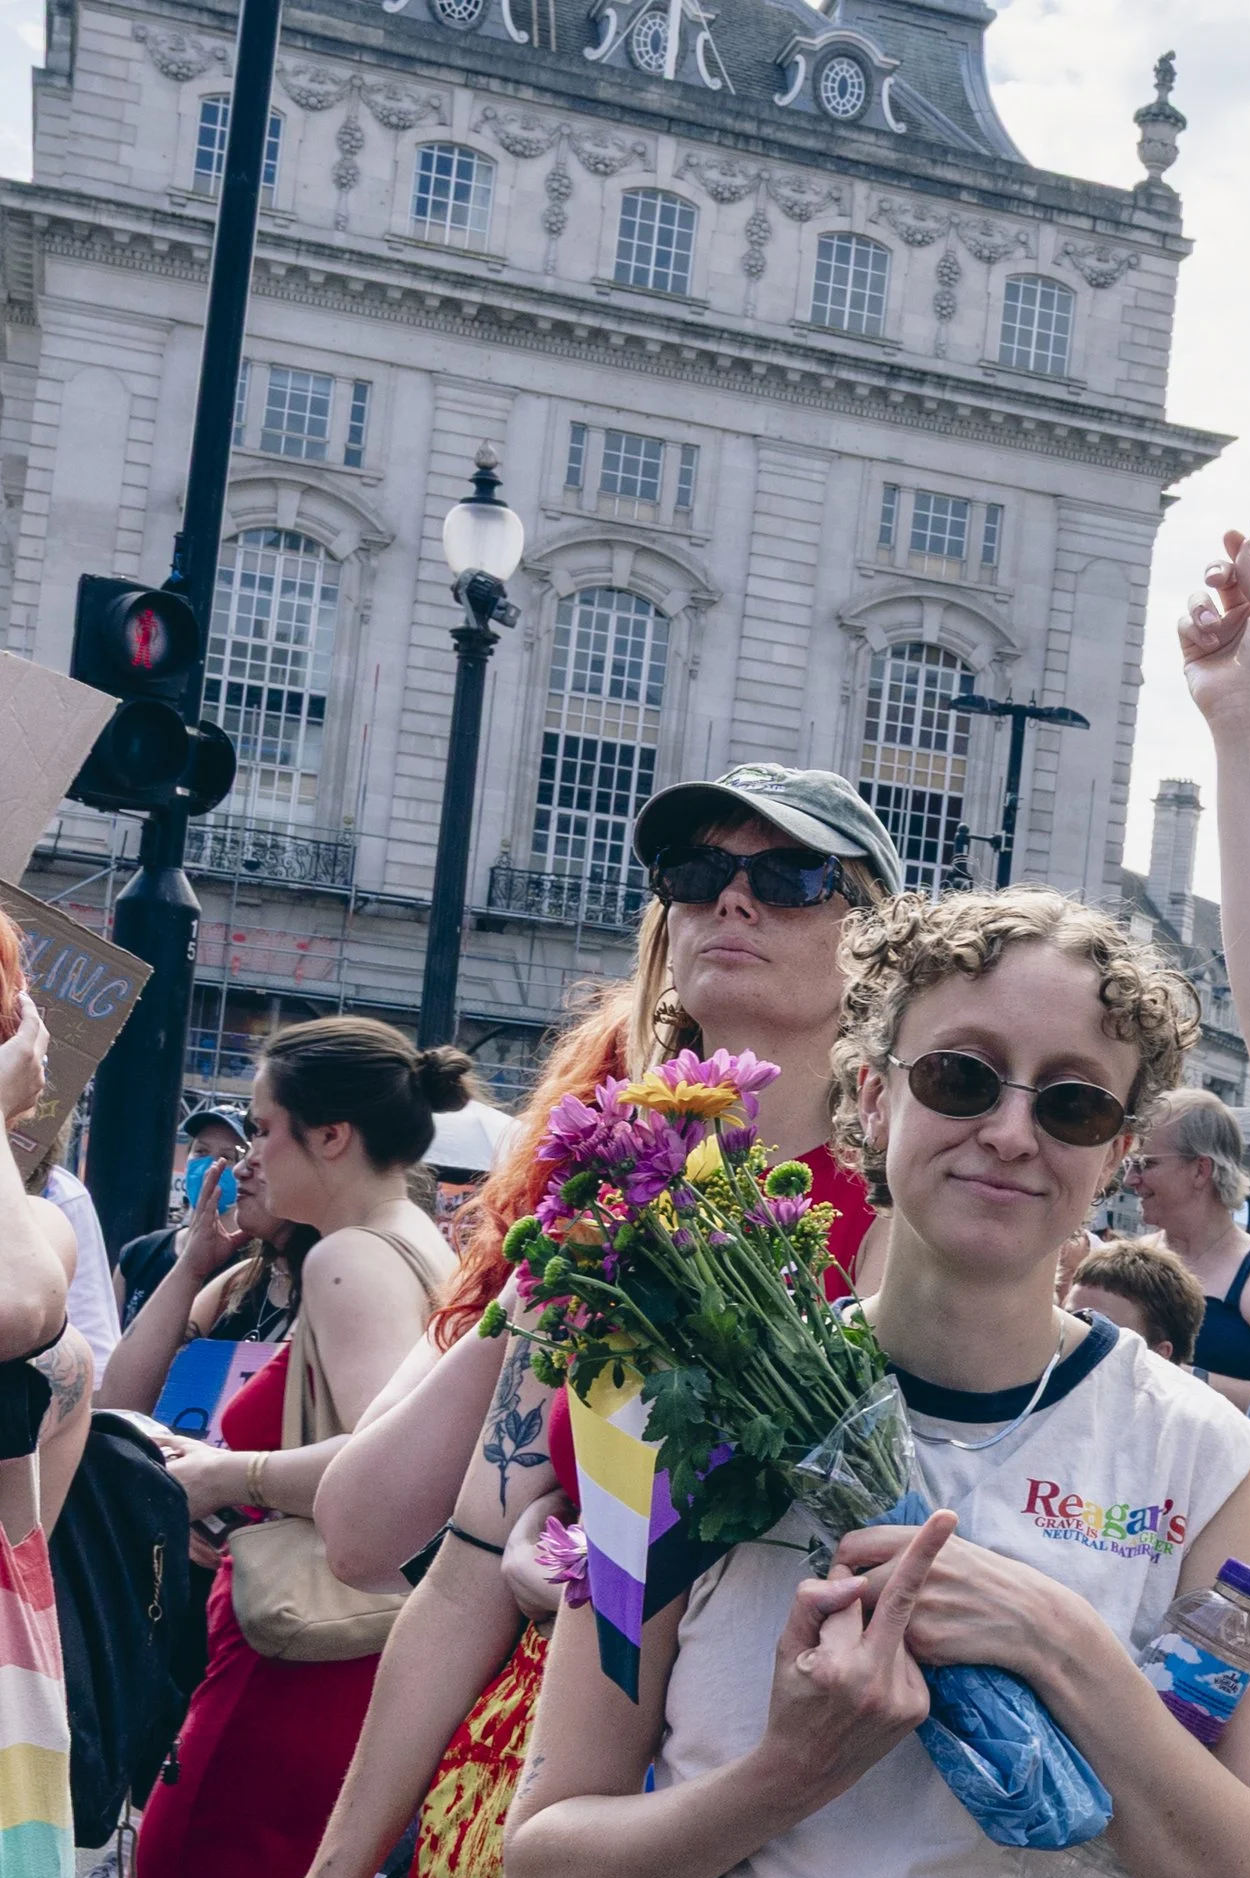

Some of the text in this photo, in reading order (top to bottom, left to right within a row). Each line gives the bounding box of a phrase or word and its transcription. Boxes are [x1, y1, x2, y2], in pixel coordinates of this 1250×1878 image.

[1035, 1516, 1084, 1531] GRAVE
[1086, 1526, 1098, 1539] IS
[1141, 1532, 1173, 1556] GEER
[1042, 1529, 1160, 1564] NEUTRAL BATHRM
